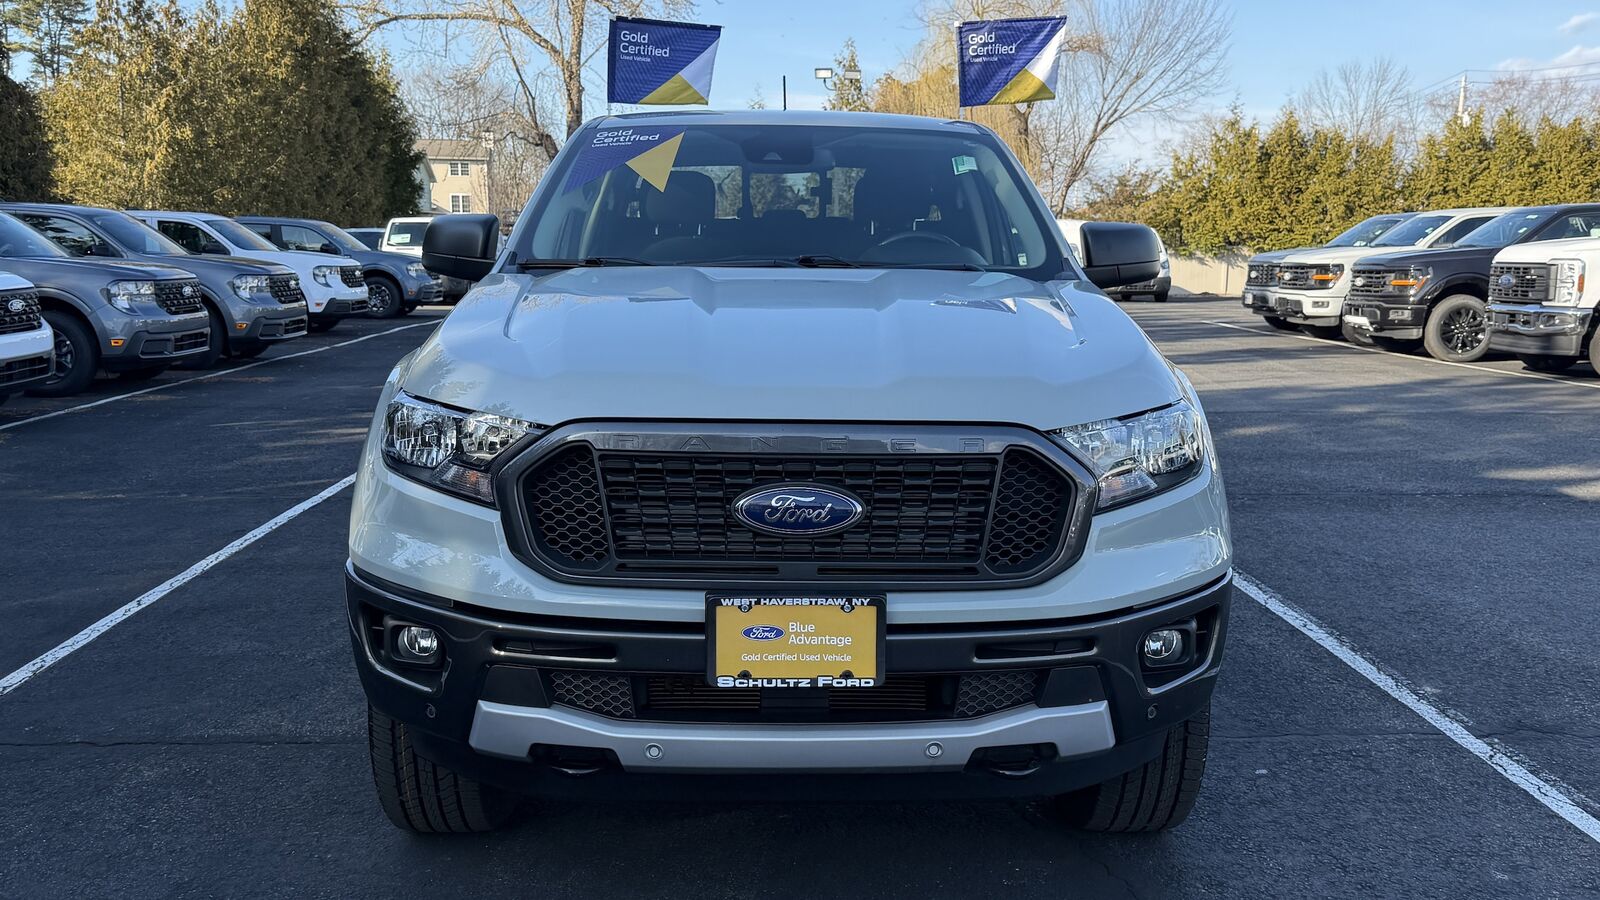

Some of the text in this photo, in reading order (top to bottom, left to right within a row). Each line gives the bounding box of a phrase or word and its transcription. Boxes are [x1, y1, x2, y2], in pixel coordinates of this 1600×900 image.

[620, 31, 649, 44] Gold
[968, 32, 995, 44] Gold
[620, 43, 670, 57] Certified
[968, 43, 1016, 56] Certified
[593, 134, 660, 144] Certified
[596, 129, 633, 138] Gold
[612, 434, 985, 453] RANGER
[764, 494, 832, 523] Ford
[721, 598, 870, 606] WEST HAVERSTRAW, NY
[750, 627, 777, 639] Ford
[789, 622, 815, 633] Blue
[788, 634, 852, 647] Advantage
[741, 653, 852, 662] Gold Certified Used Vehicle
